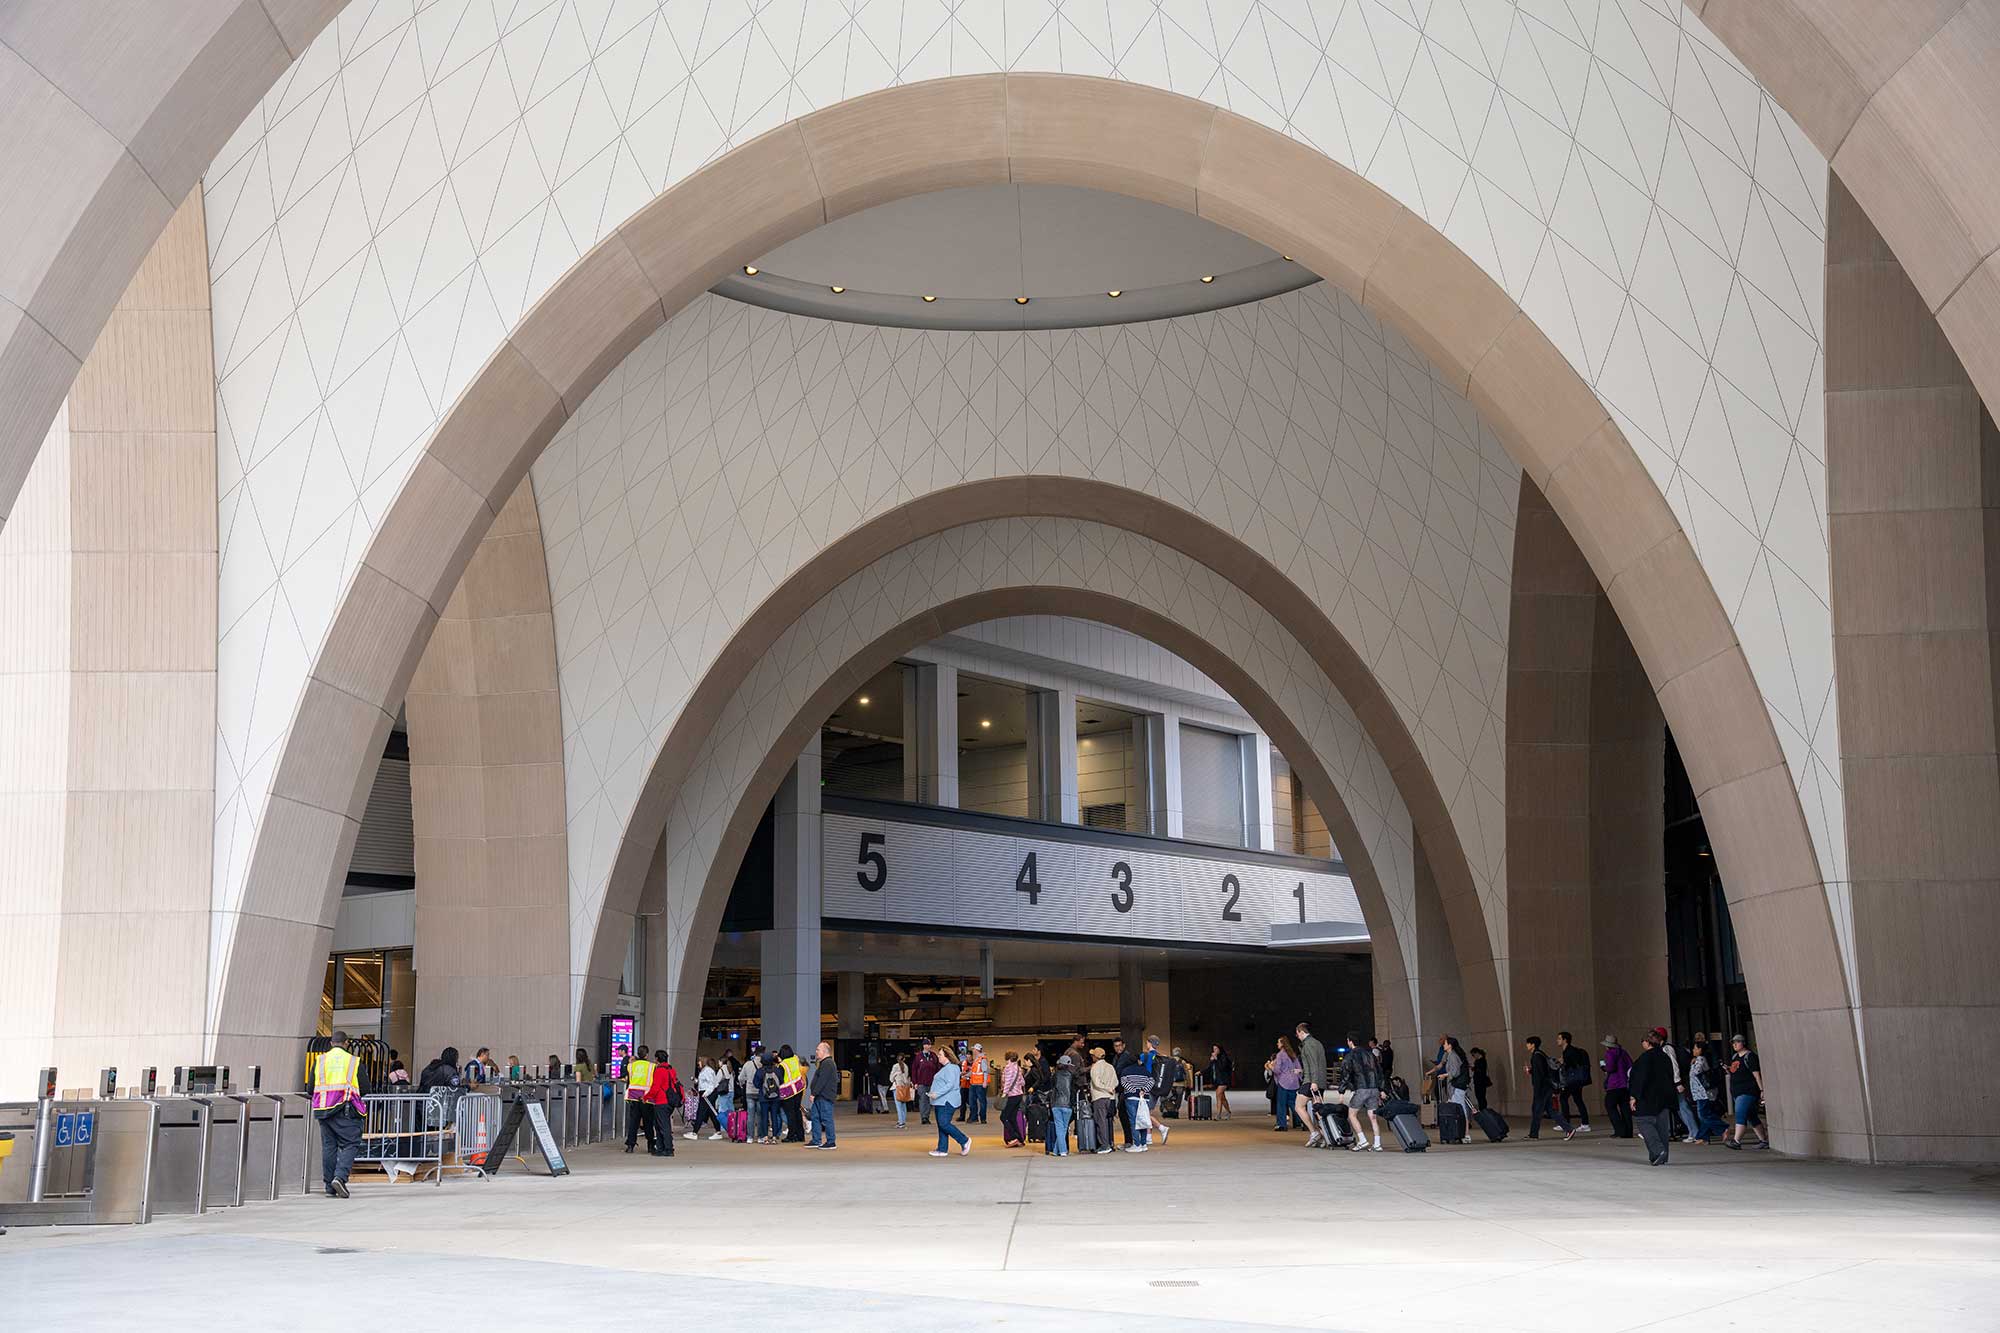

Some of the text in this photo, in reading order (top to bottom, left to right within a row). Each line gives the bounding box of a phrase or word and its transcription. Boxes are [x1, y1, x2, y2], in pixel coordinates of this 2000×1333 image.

[857, 832, 1305, 923] 5 4 3 2 1
